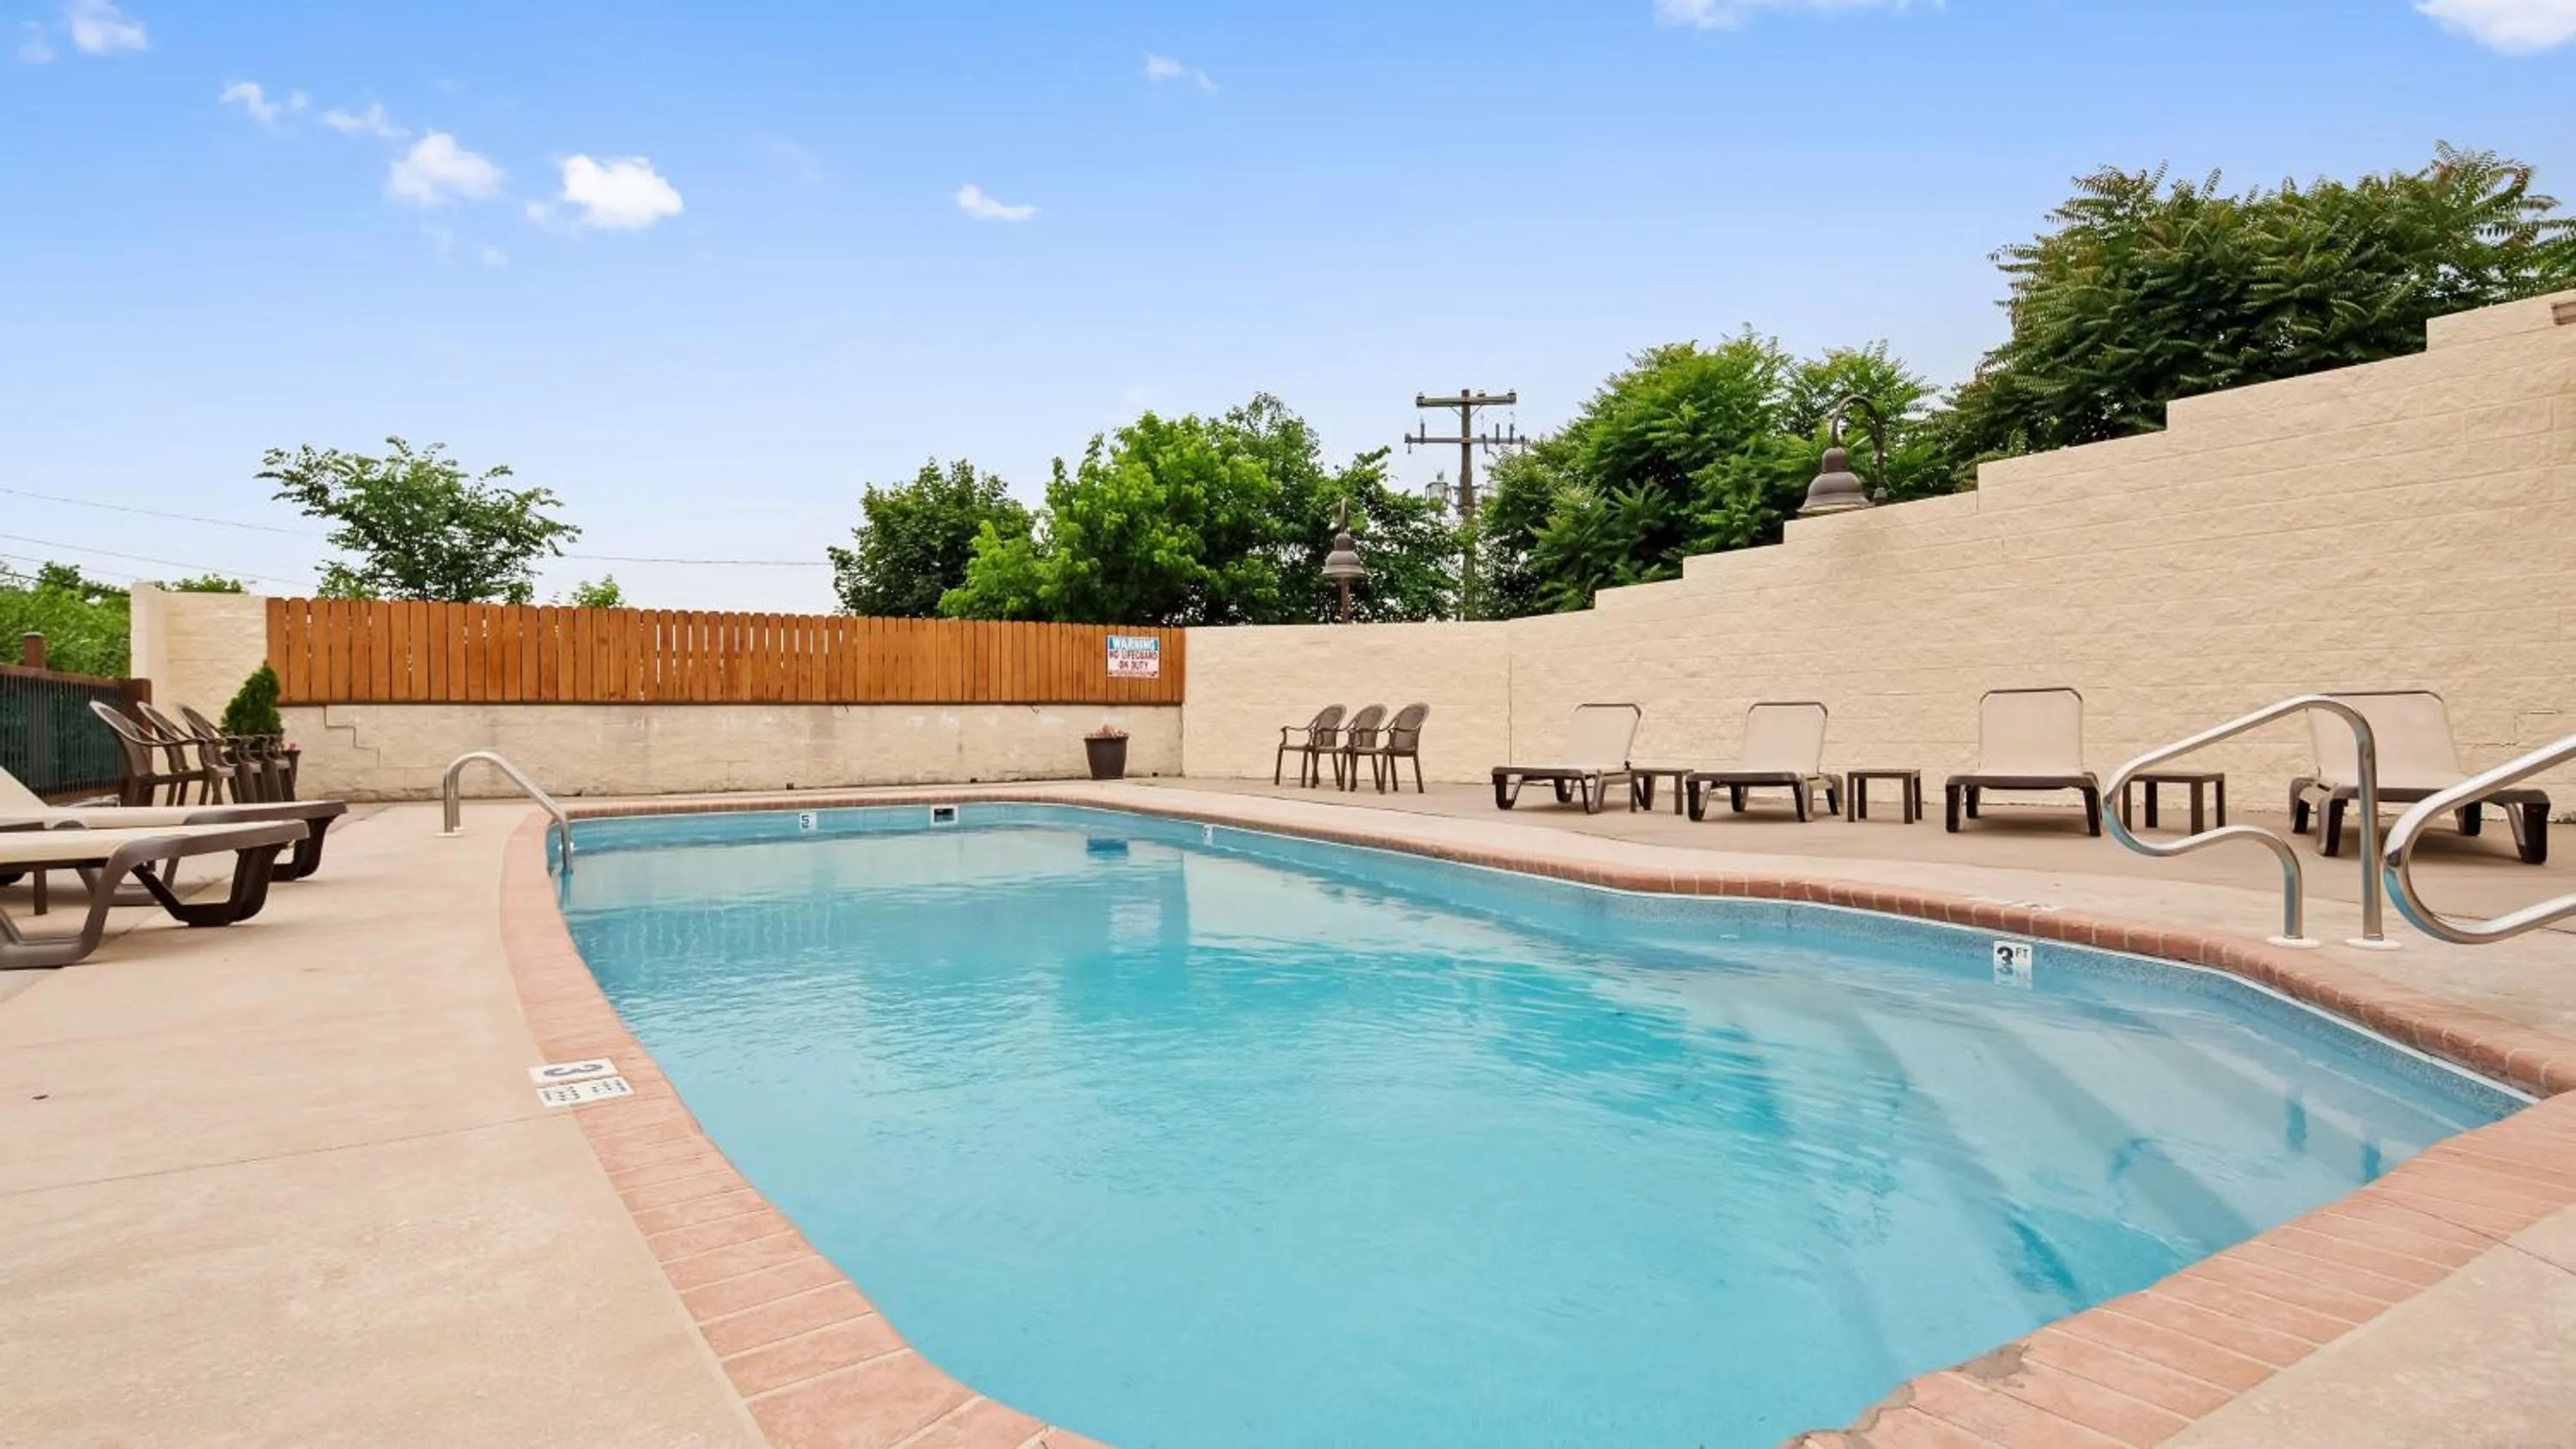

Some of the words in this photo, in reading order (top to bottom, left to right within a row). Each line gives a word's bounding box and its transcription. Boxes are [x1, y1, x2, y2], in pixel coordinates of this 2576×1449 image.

[1996, 946, 2014, 966] 3
[2015, 948, 2030, 958] FT
[544, 1064, 604, 1076] 3
